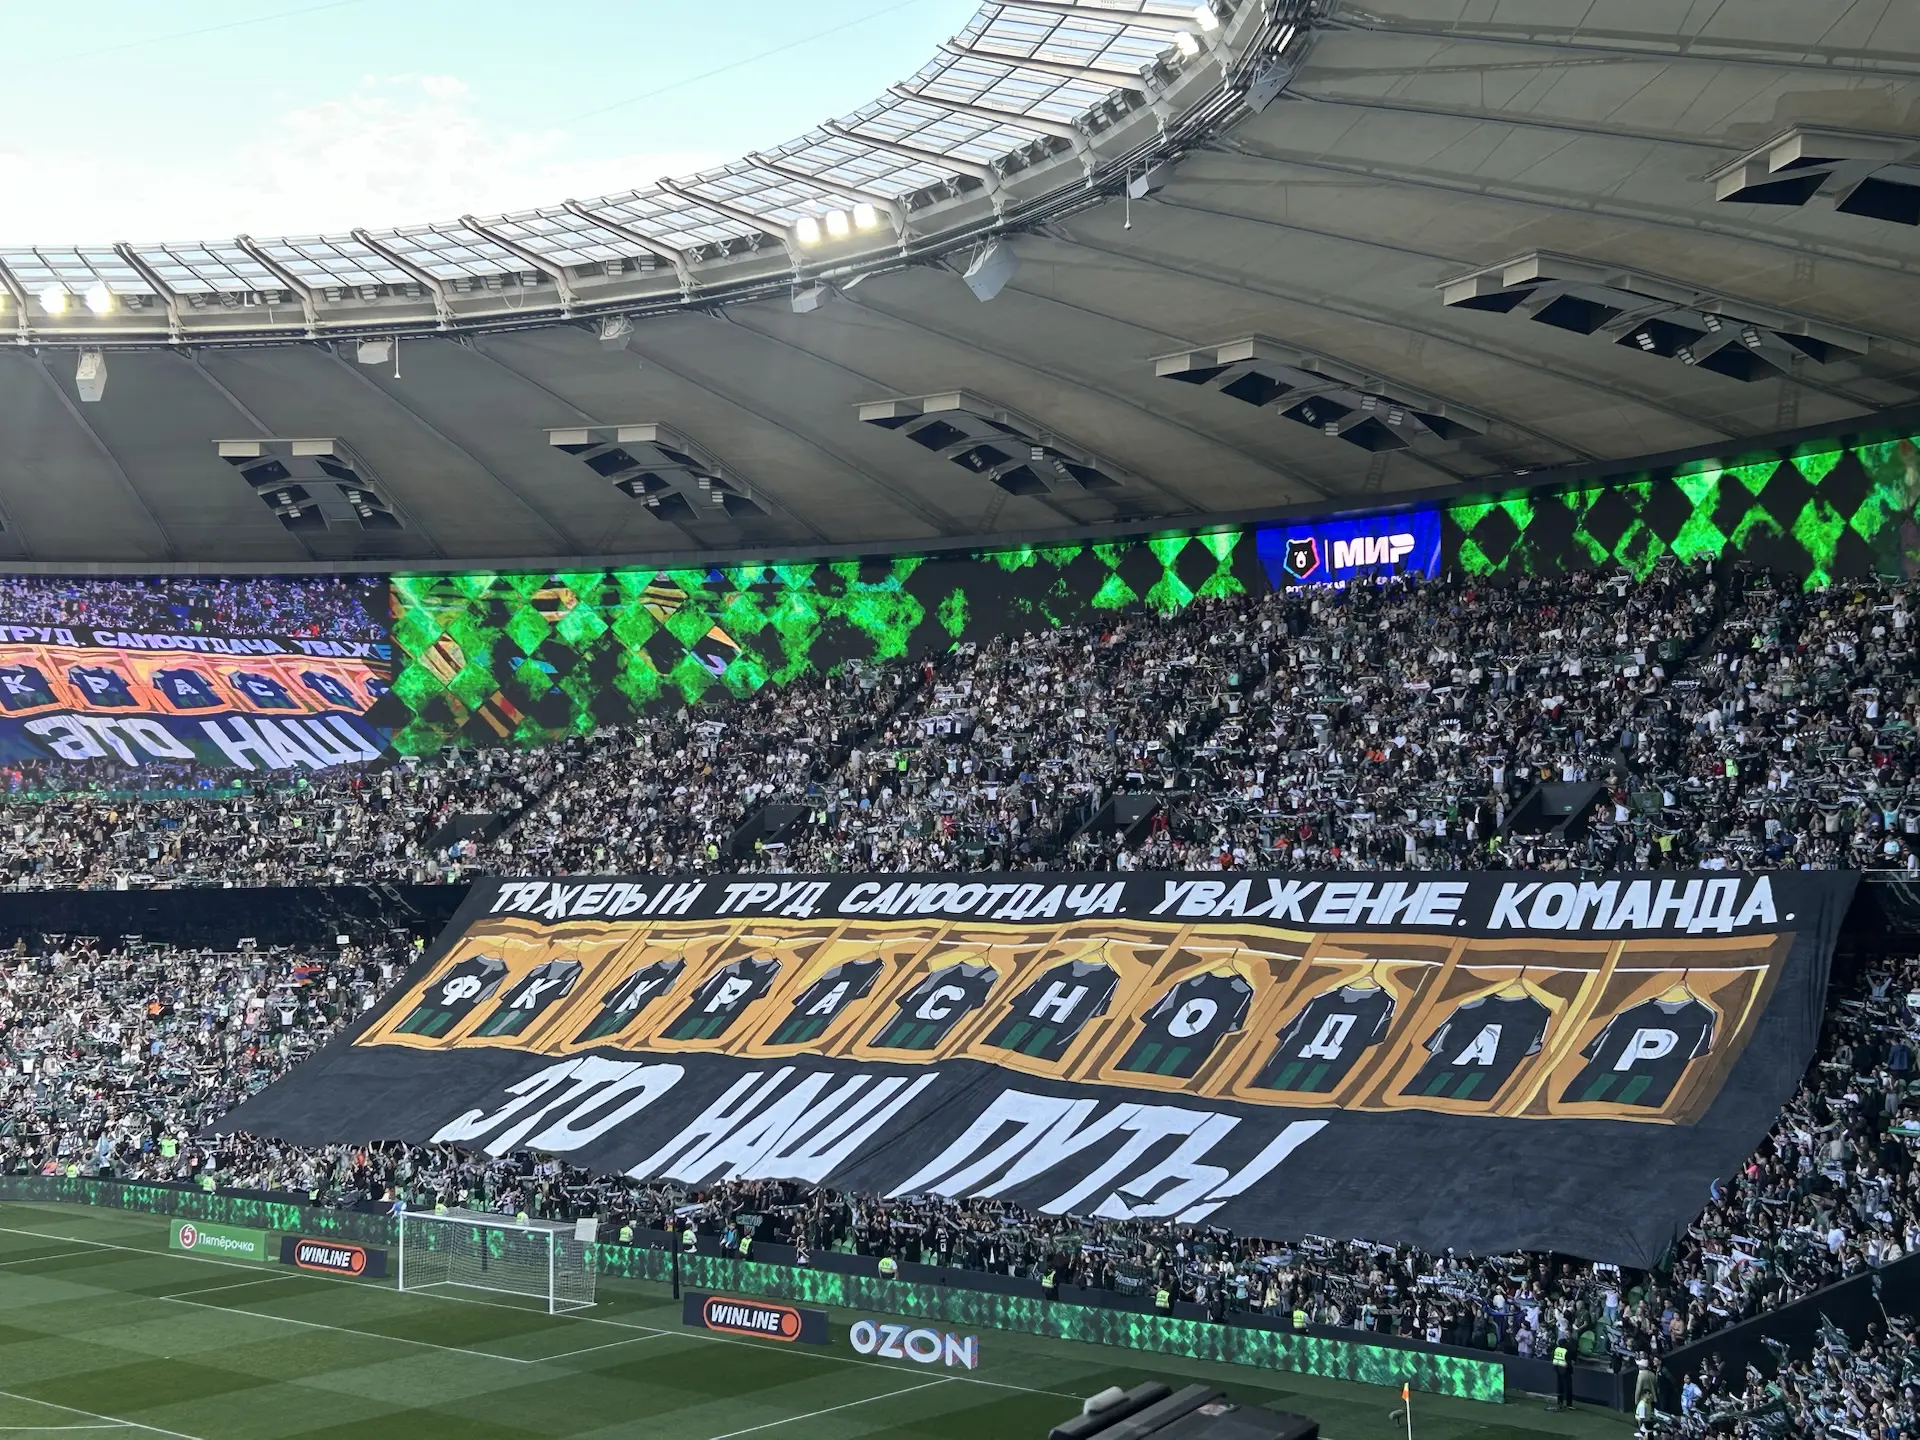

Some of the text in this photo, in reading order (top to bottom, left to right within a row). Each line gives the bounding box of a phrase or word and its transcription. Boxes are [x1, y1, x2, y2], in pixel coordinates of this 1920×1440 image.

[1333, 533, 1416, 569] МИР
[24, 714, 383, 771] ЭТО НАШ
[489, 875, 1796, 934] ТЯЖЕЛЫЙ ТРУД. САМООТДАЧА. УВАЖЕНИЕ. КОМАНДА.
[429, 1055, 1330, 1224] ЭТО НАШ ПУТЬ!
[198, 1231, 255, 1252] Пятёрочка
[300, 1245, 351, 1268] WINLINE
[711, 1303, 780, 1332] WINLINE
[850, 1319, 978, 1370] OZON
